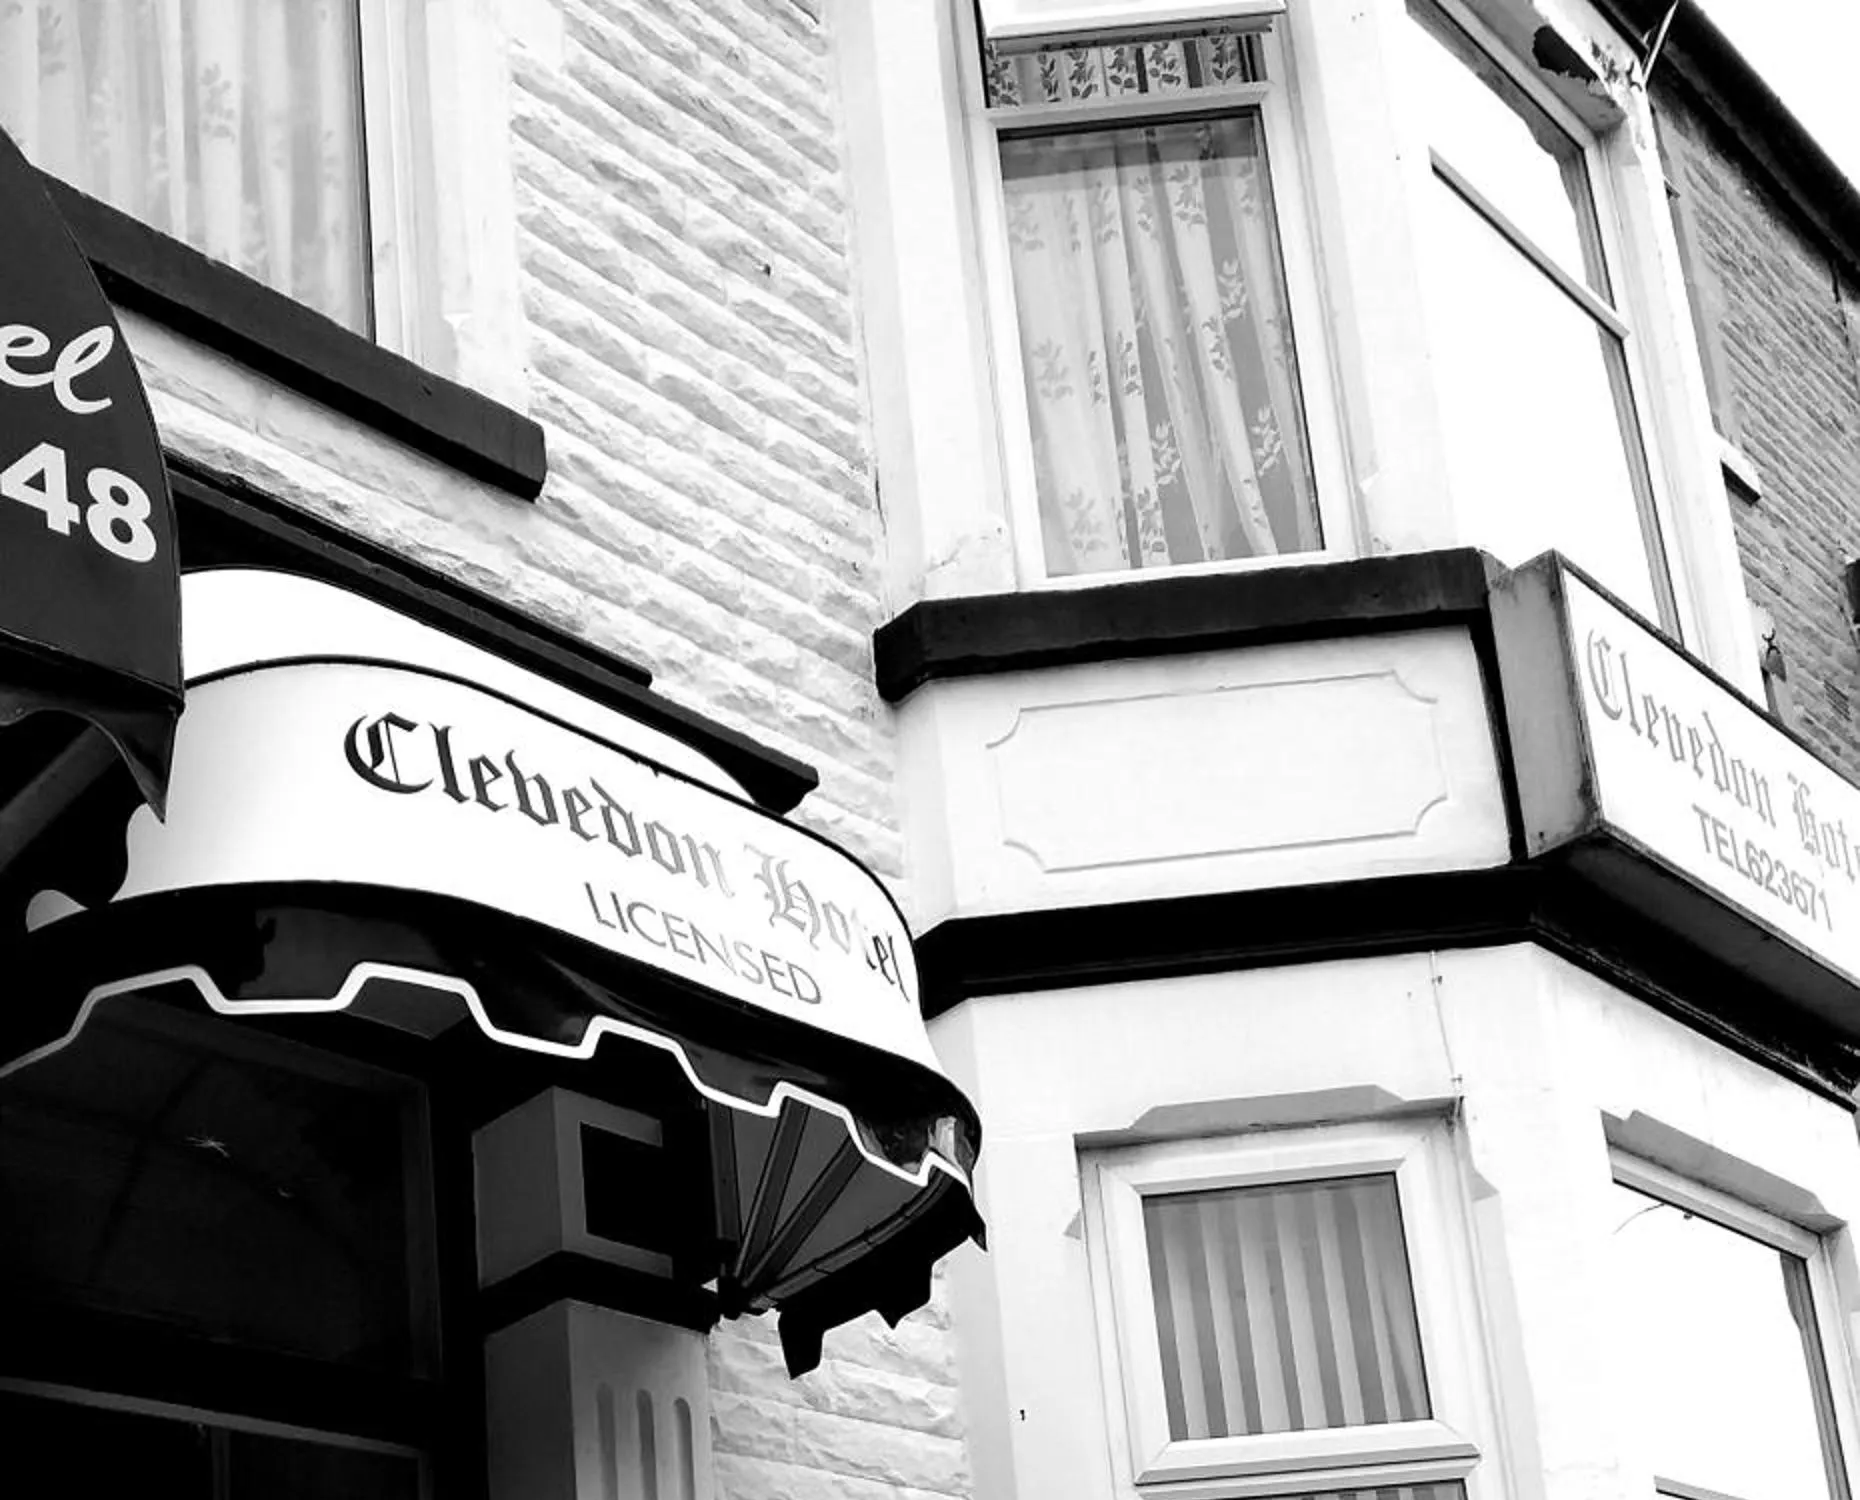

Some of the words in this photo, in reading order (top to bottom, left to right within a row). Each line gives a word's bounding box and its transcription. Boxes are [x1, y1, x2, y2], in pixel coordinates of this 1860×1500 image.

[343, 712, 736, 899] Clevedon
[743, 843, 911, 1003] Hotel
[1587, 628, 1777, 829] Clevedon
[1787, 772, 1860, 880] Hot
[584, 882, 823, 1005] LICENSED
